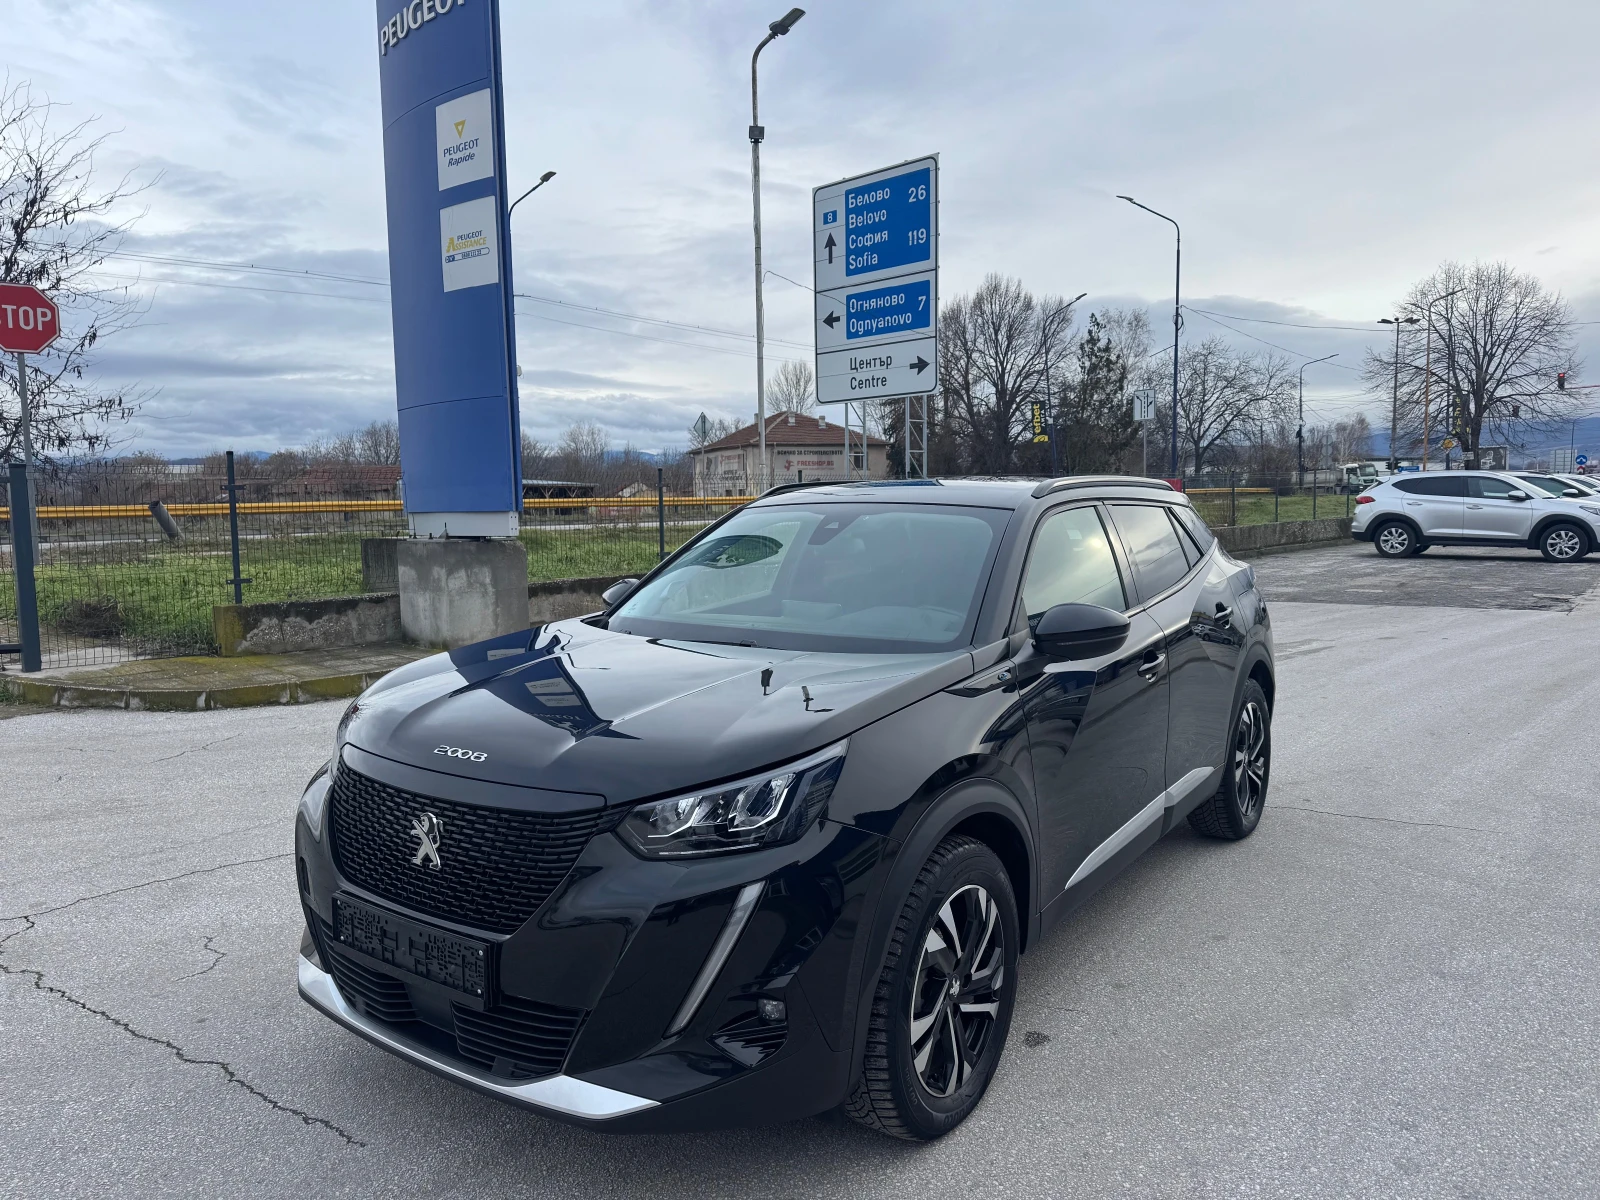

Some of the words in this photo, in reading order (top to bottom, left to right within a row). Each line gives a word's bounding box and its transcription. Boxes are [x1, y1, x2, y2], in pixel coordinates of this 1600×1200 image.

[380, 0, 466, 56] PEUGE
[443, 138, 479, 157] PEUGEOT
[447, 152, 475, 167] Rapide
[848, 187, 890, 208] Белово
[908, 184, 926, 203] 26
[827, 212, 833, 223] 8
[848, 208, 887, 229] Belovo
[446, 236, 487, 253] ASSISTANCE
[457, 230, 483, 241] PEUGEOT
[848, 229, 888, 249] София
[908, 228, 926, 246] 119
[849, 252, 878, 269] Sofia
[849, 293, 905, 313] Огняново
[917, 295, 926, 311] 7
[0, 304, 51, 331] TOP
[849, 311, 912, 334] Ognyanovo
[850, 354, 892, 374] Център
[850, 375, 887, 390] Centre
[1033, 403, 1041, 434] efbet
[433, 744, 488, 762] 2008
